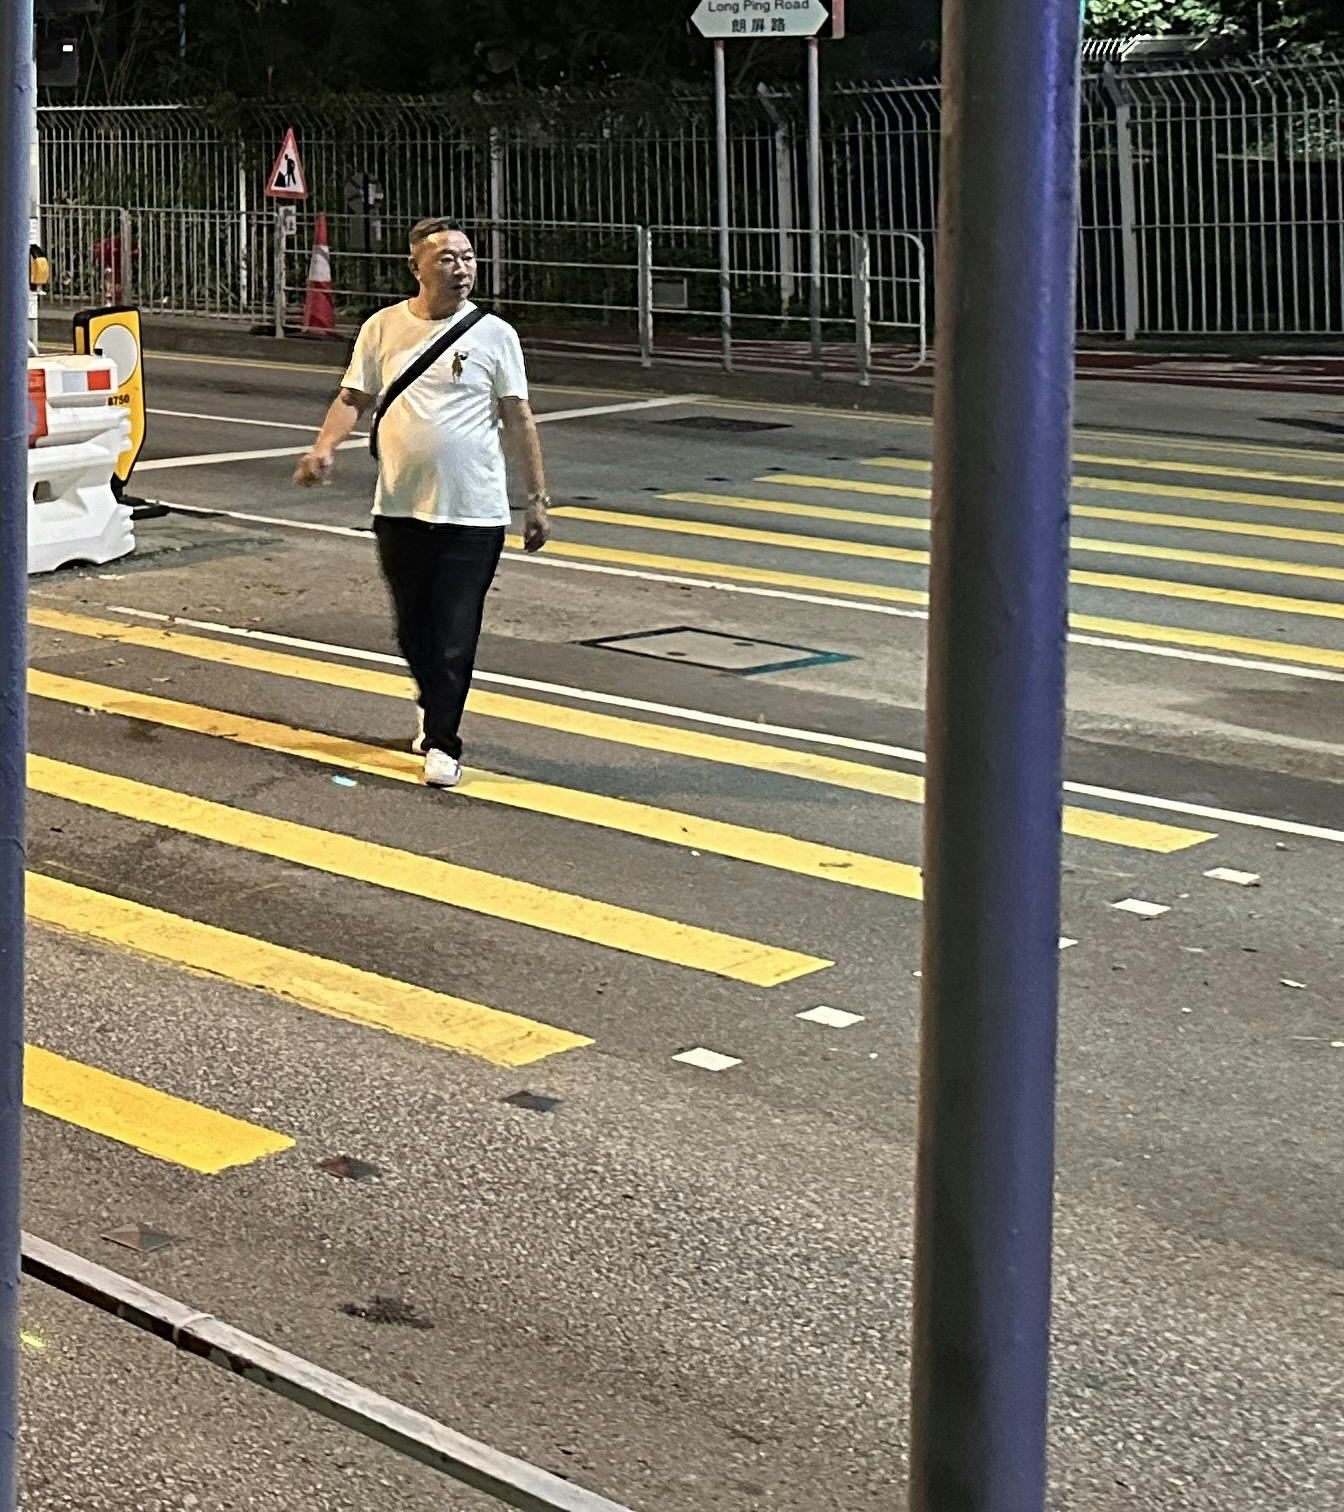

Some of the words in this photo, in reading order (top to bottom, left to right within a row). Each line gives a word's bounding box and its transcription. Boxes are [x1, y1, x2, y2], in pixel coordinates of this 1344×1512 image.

[708, 0, 740, 14] Long
[743, 0, 771, 13] Ping
[731, 17, 786, 33] 朗屏路
